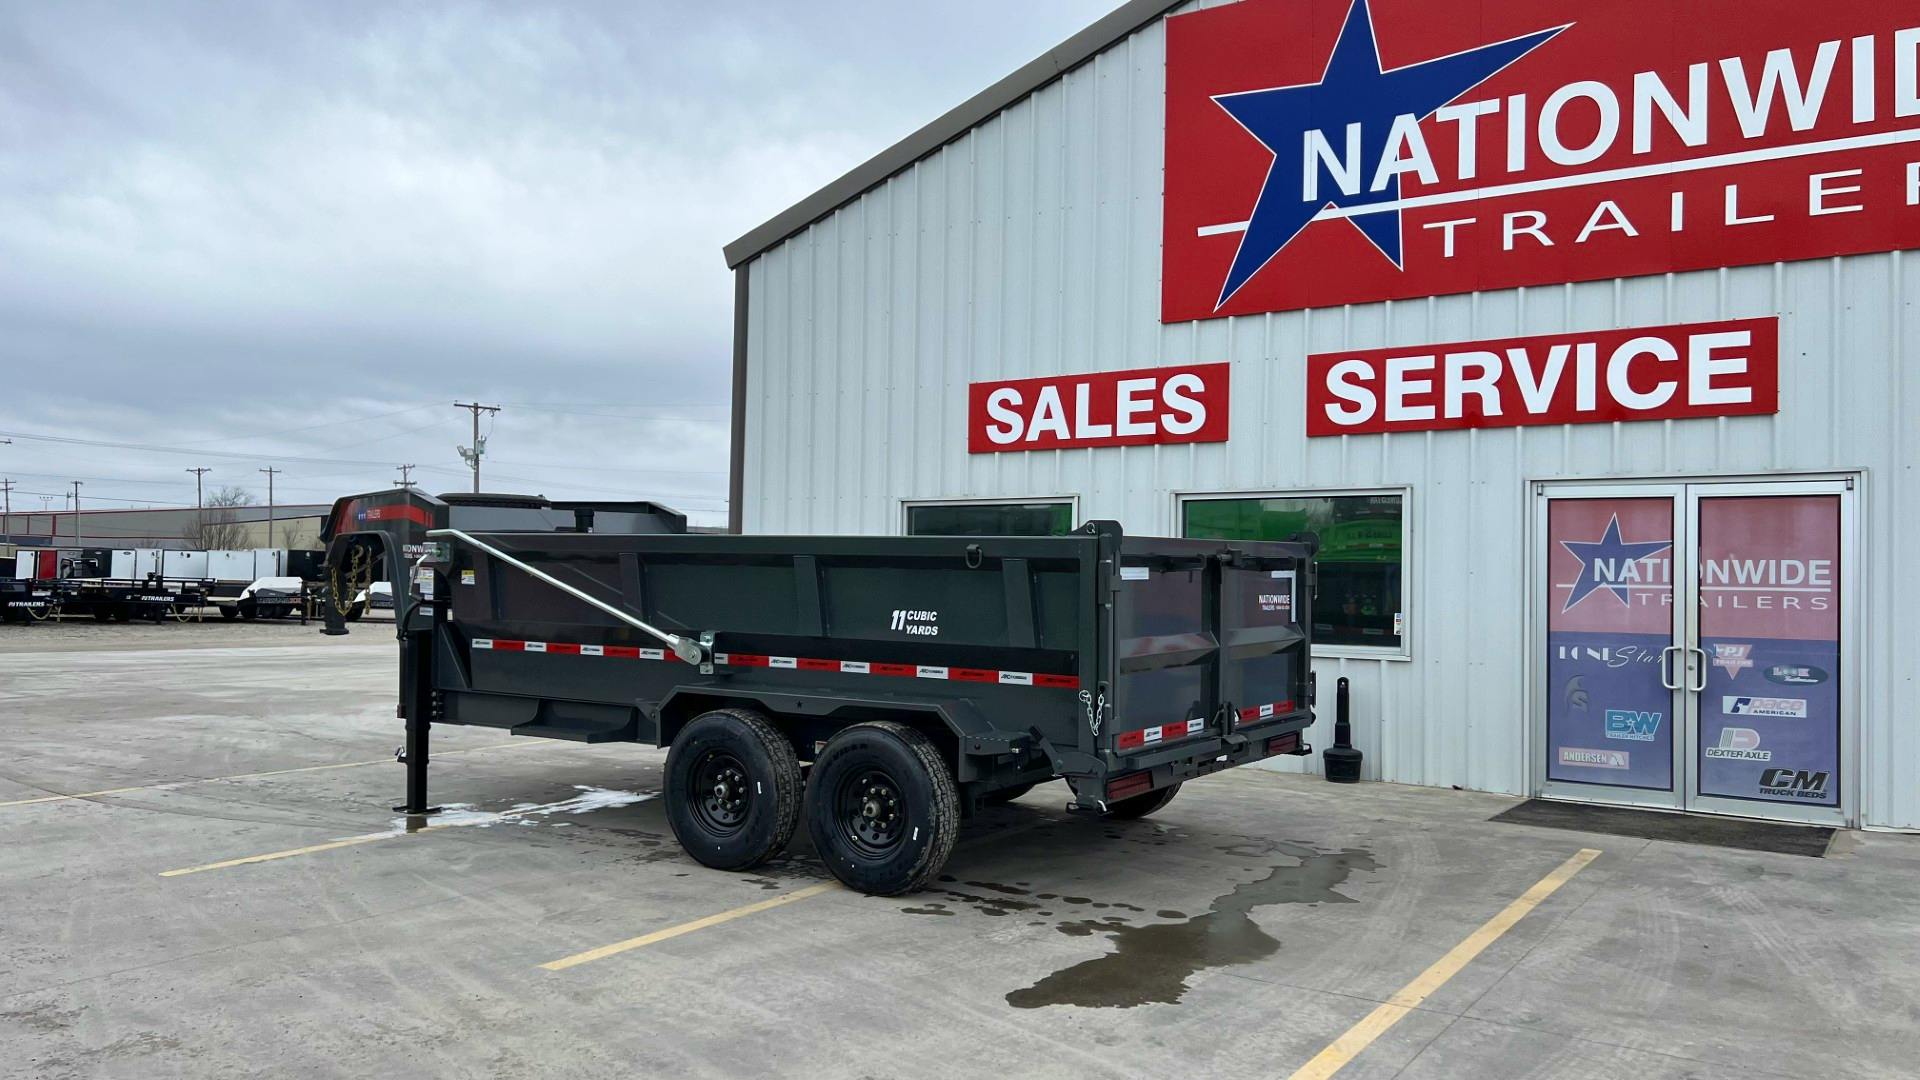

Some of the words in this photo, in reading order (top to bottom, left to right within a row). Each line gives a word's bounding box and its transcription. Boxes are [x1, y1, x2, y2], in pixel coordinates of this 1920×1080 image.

[1423, 162, 1920, 258] TRAILE
[1324, 330, 1754, 426] SERVICE
[985, 374, 1208, 445] SALES
[1593, 558, 1832, 586] NATINWIDE
[890, 609, 907, 630] 11
[906, 610, 938, 621] CUBIC
[905, 624, 939, 636] YARDS
[1707, 748, 1743, 758] DEXTER
[1743, 751, 1770, 760] AXLE
[1759, 767, 1830, 792] CM
[1759, 787, 1796, 798] TRUCK
[1796, 790, 1828, 800] BEDS
